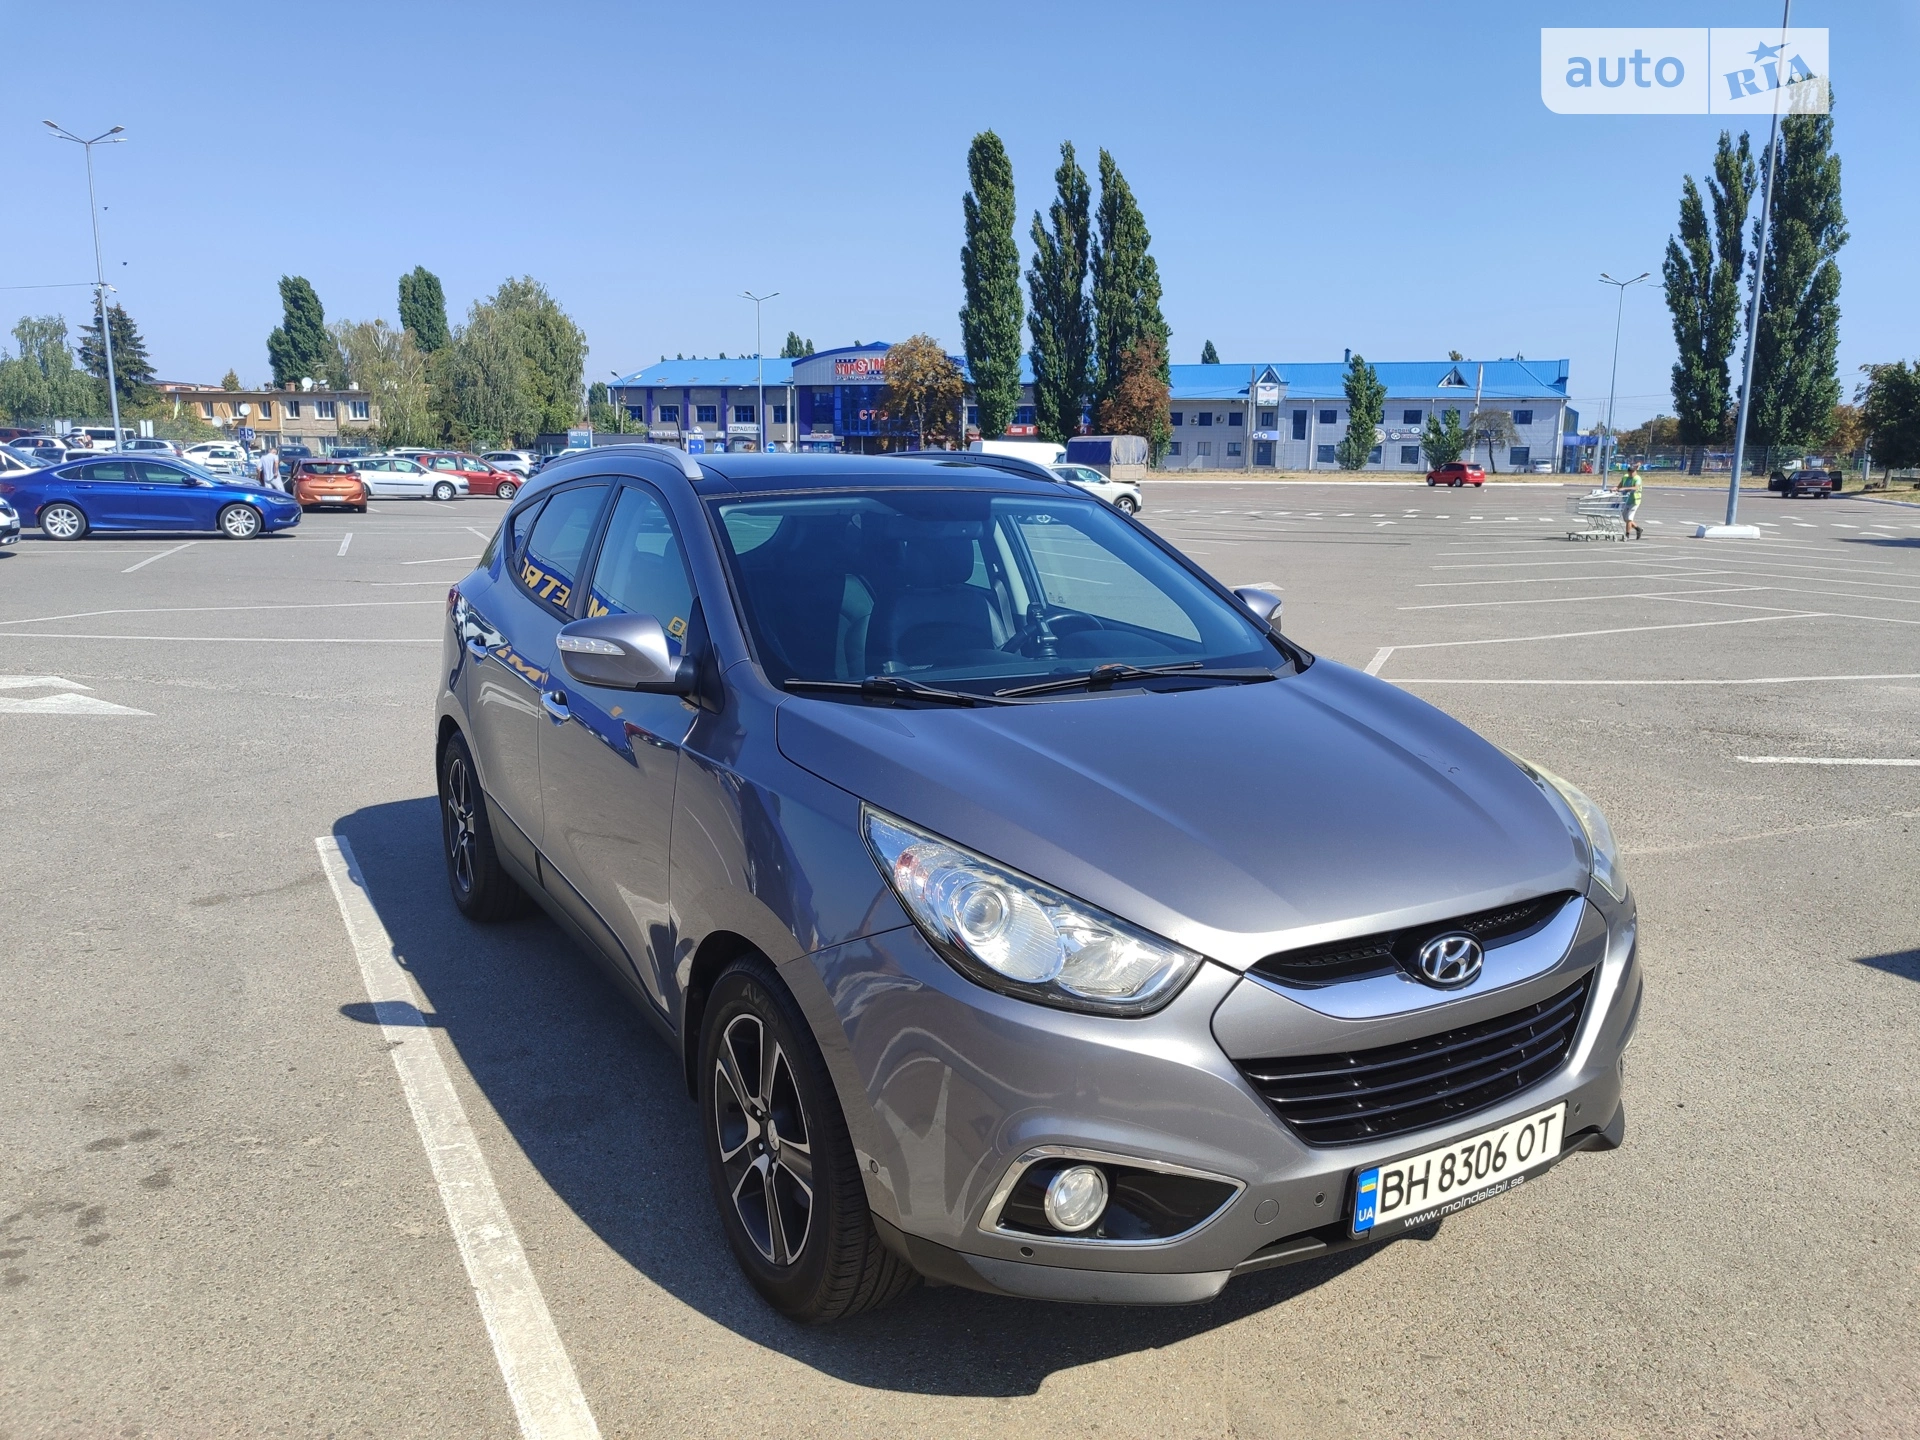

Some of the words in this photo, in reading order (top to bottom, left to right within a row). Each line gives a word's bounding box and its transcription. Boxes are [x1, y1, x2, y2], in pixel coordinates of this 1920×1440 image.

[835, 363, 855, 375] STOP
[1380, 1159, 1432, 1214] BH
[1438, 1131, 1510, 1193] 8306
[1516, 1113, 1557, 1163] OT
[1358, 1206, 1374, 1222] UA
[1404, 1175, 1525, 1227] www.molndalsbil.se
